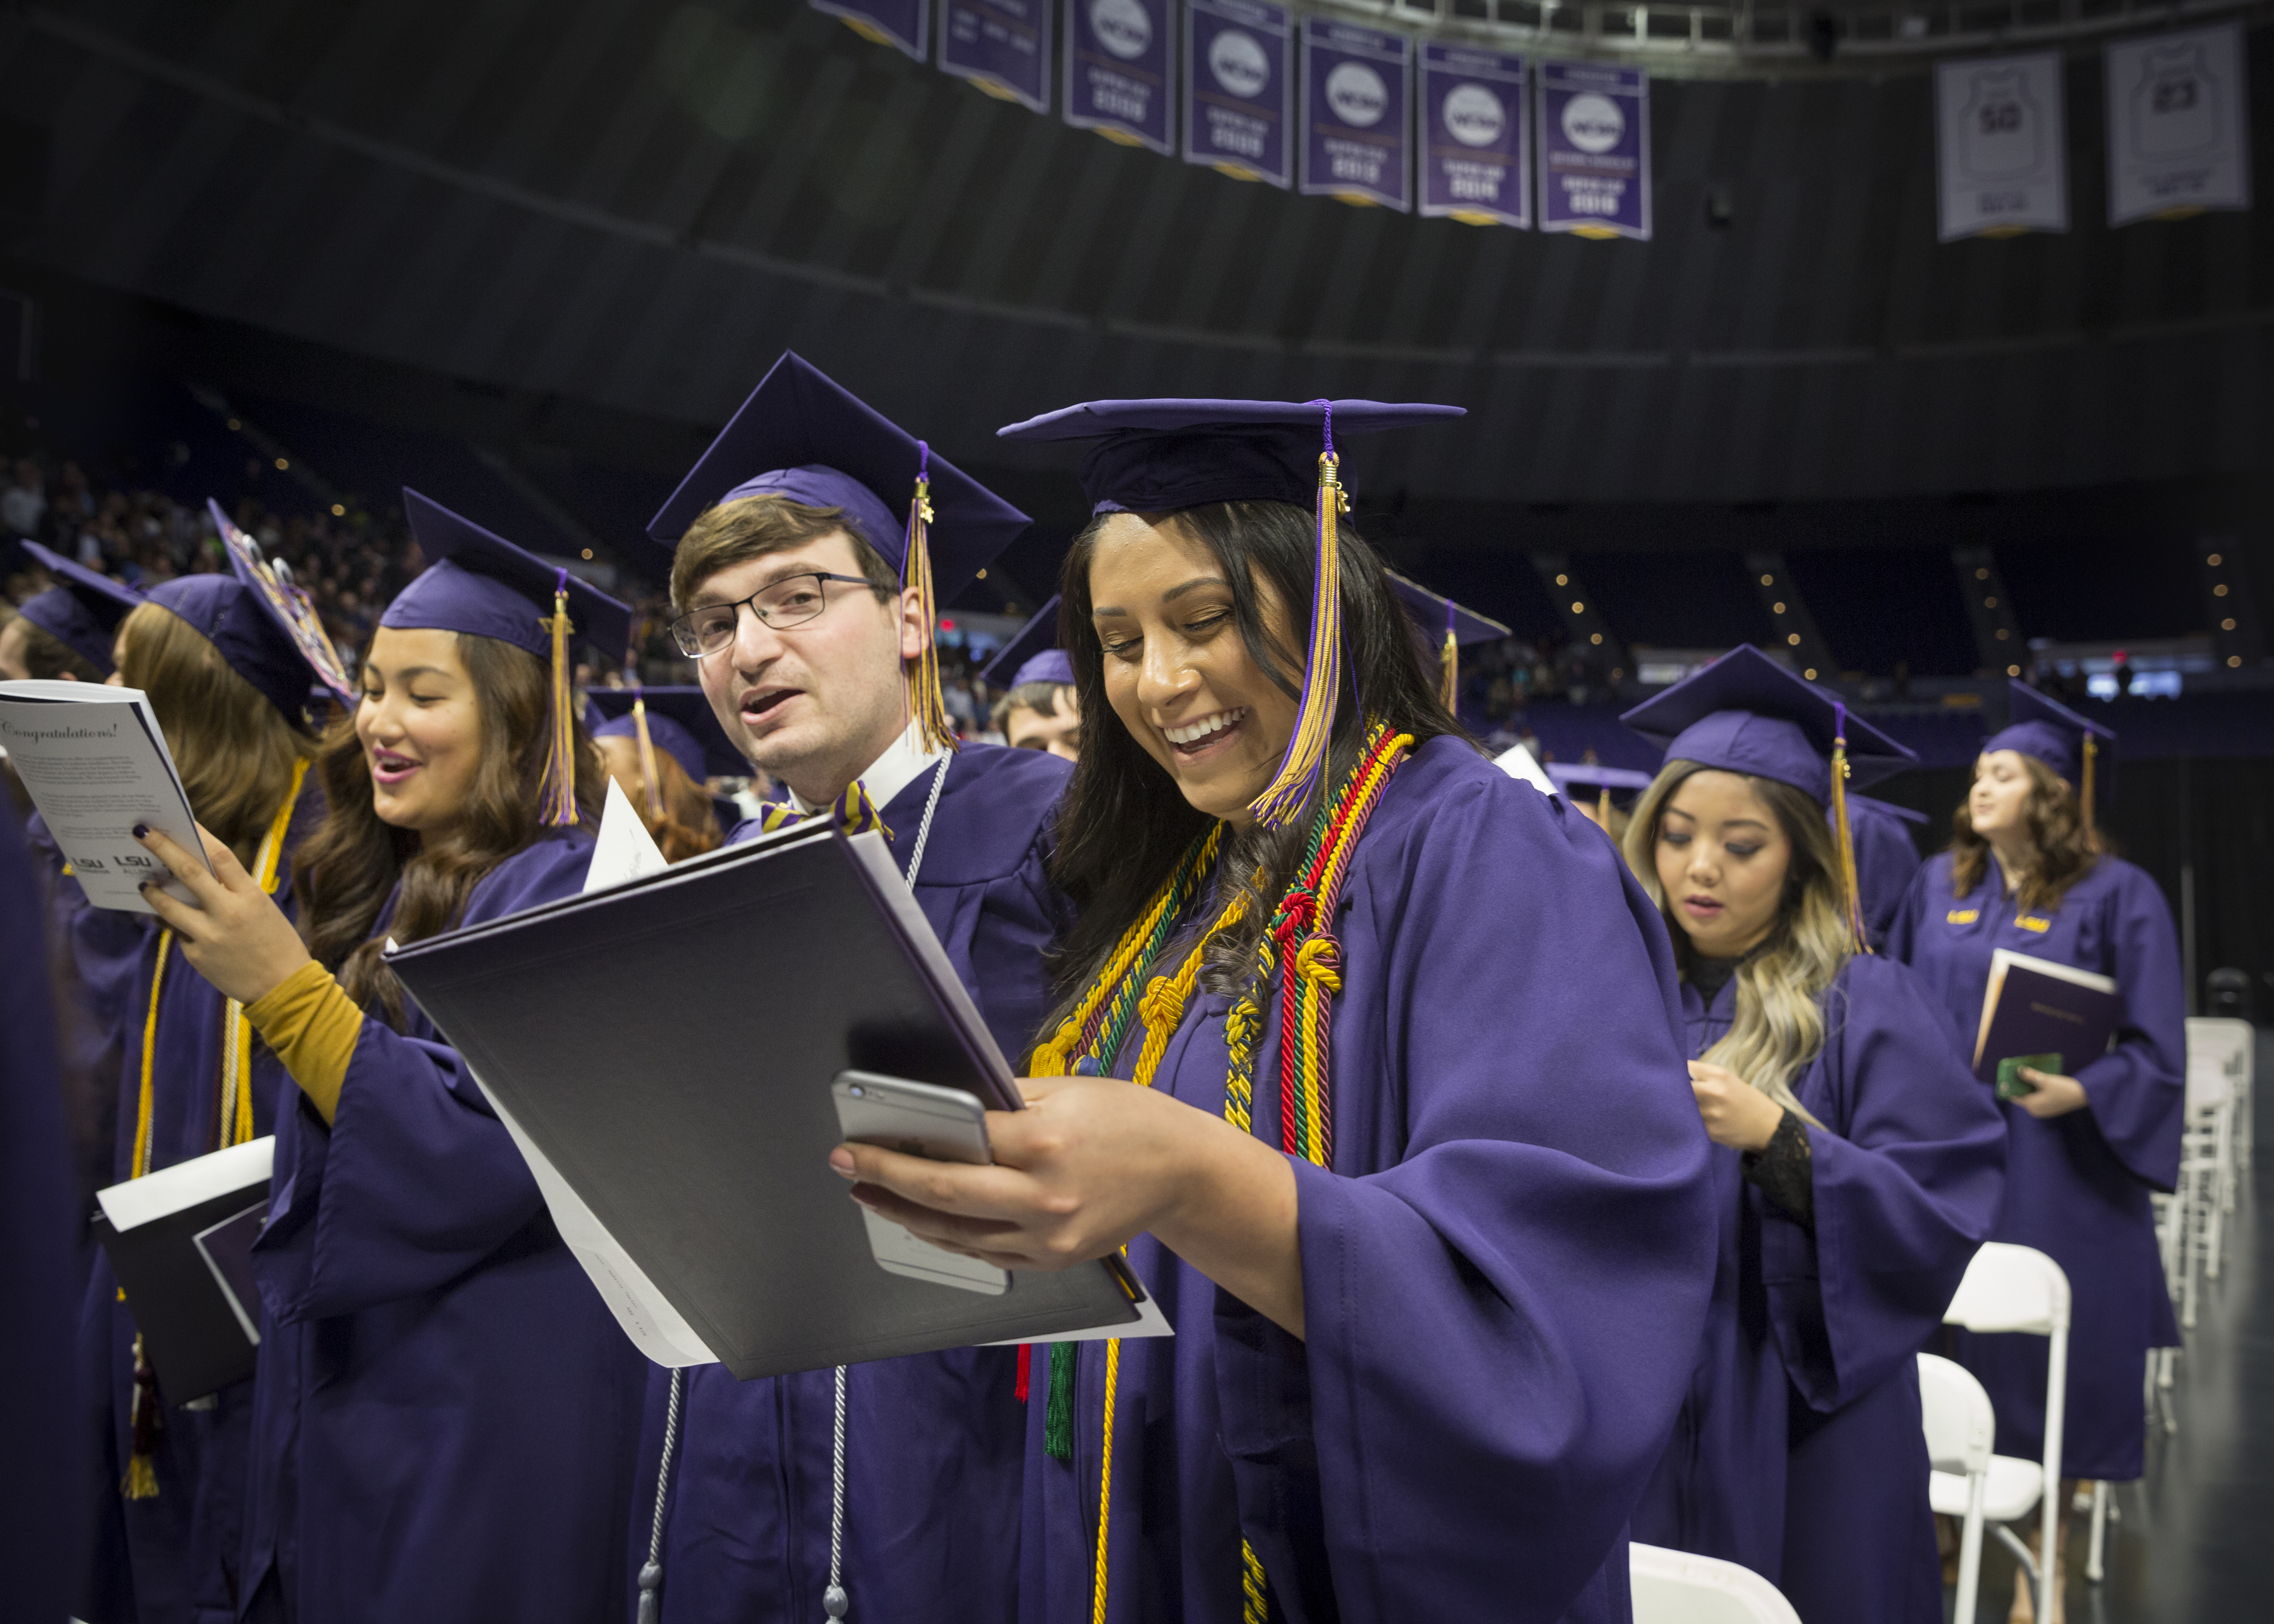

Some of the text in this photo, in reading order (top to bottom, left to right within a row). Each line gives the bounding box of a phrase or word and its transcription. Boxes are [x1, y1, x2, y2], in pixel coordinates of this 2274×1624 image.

[1, 721, 117, 743] Congratulations!
[71, 857, 104, 869] LSU
[113, 855, 152, 867] LSU
